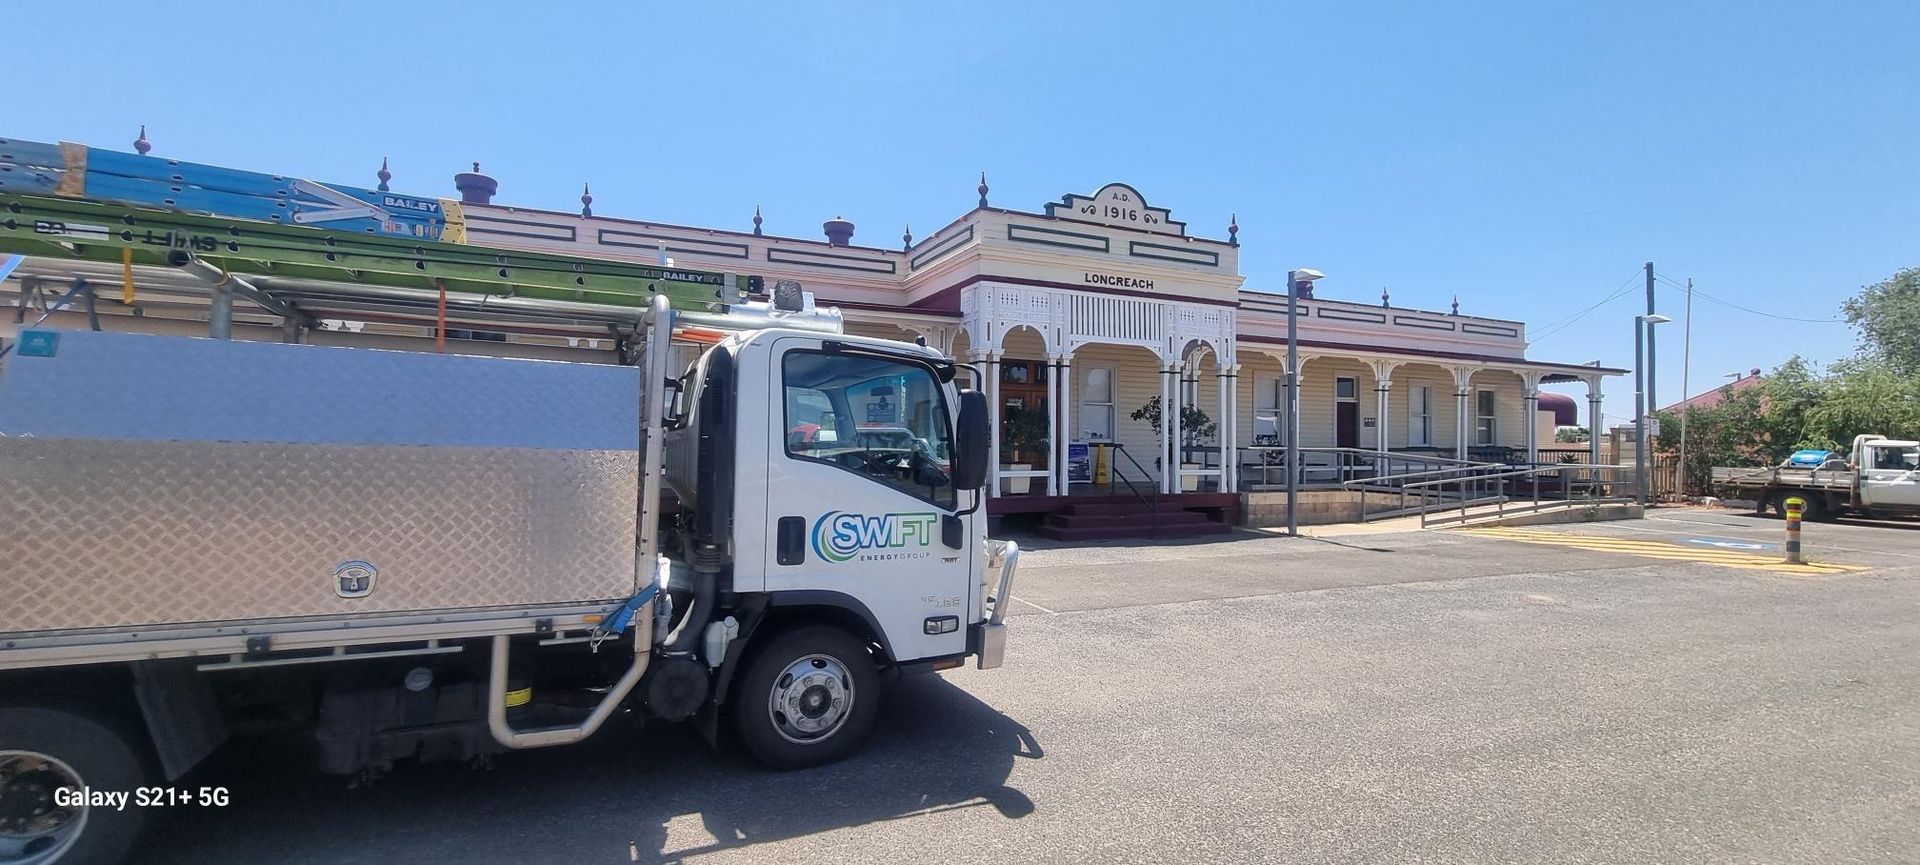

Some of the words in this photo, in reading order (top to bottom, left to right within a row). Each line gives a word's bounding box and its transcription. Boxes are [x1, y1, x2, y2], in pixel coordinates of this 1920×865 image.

[1112, 192, 1130, 202] A.D.
[1104, 205, 1137, 220] 1916
[664, 272, 702, 281] BAILEY
[1085, 274, 1153, 289] LONGREACH
[832, 512, 938, 550] SWIFT
